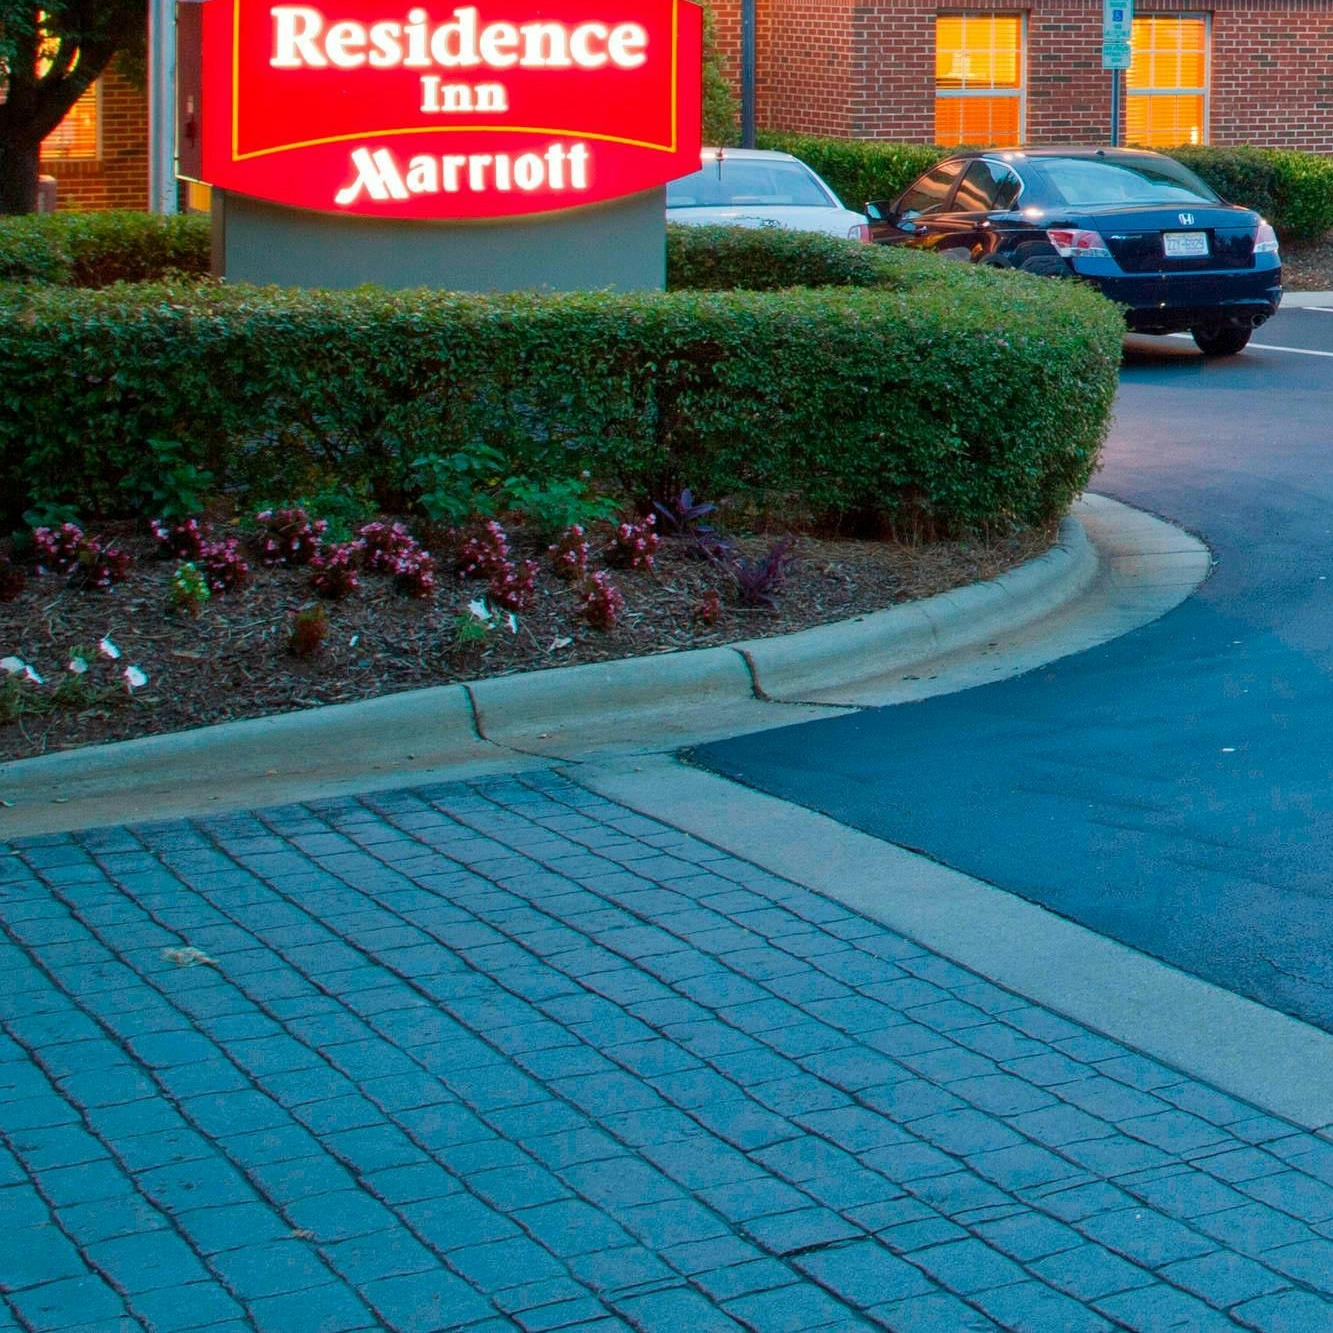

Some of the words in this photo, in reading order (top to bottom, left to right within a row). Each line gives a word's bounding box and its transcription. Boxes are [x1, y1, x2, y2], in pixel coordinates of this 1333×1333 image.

[269, 6, 647, 68] Residence
[420, 75, 508, 113] Inn
[335, 143, 588, 204] Marriott
